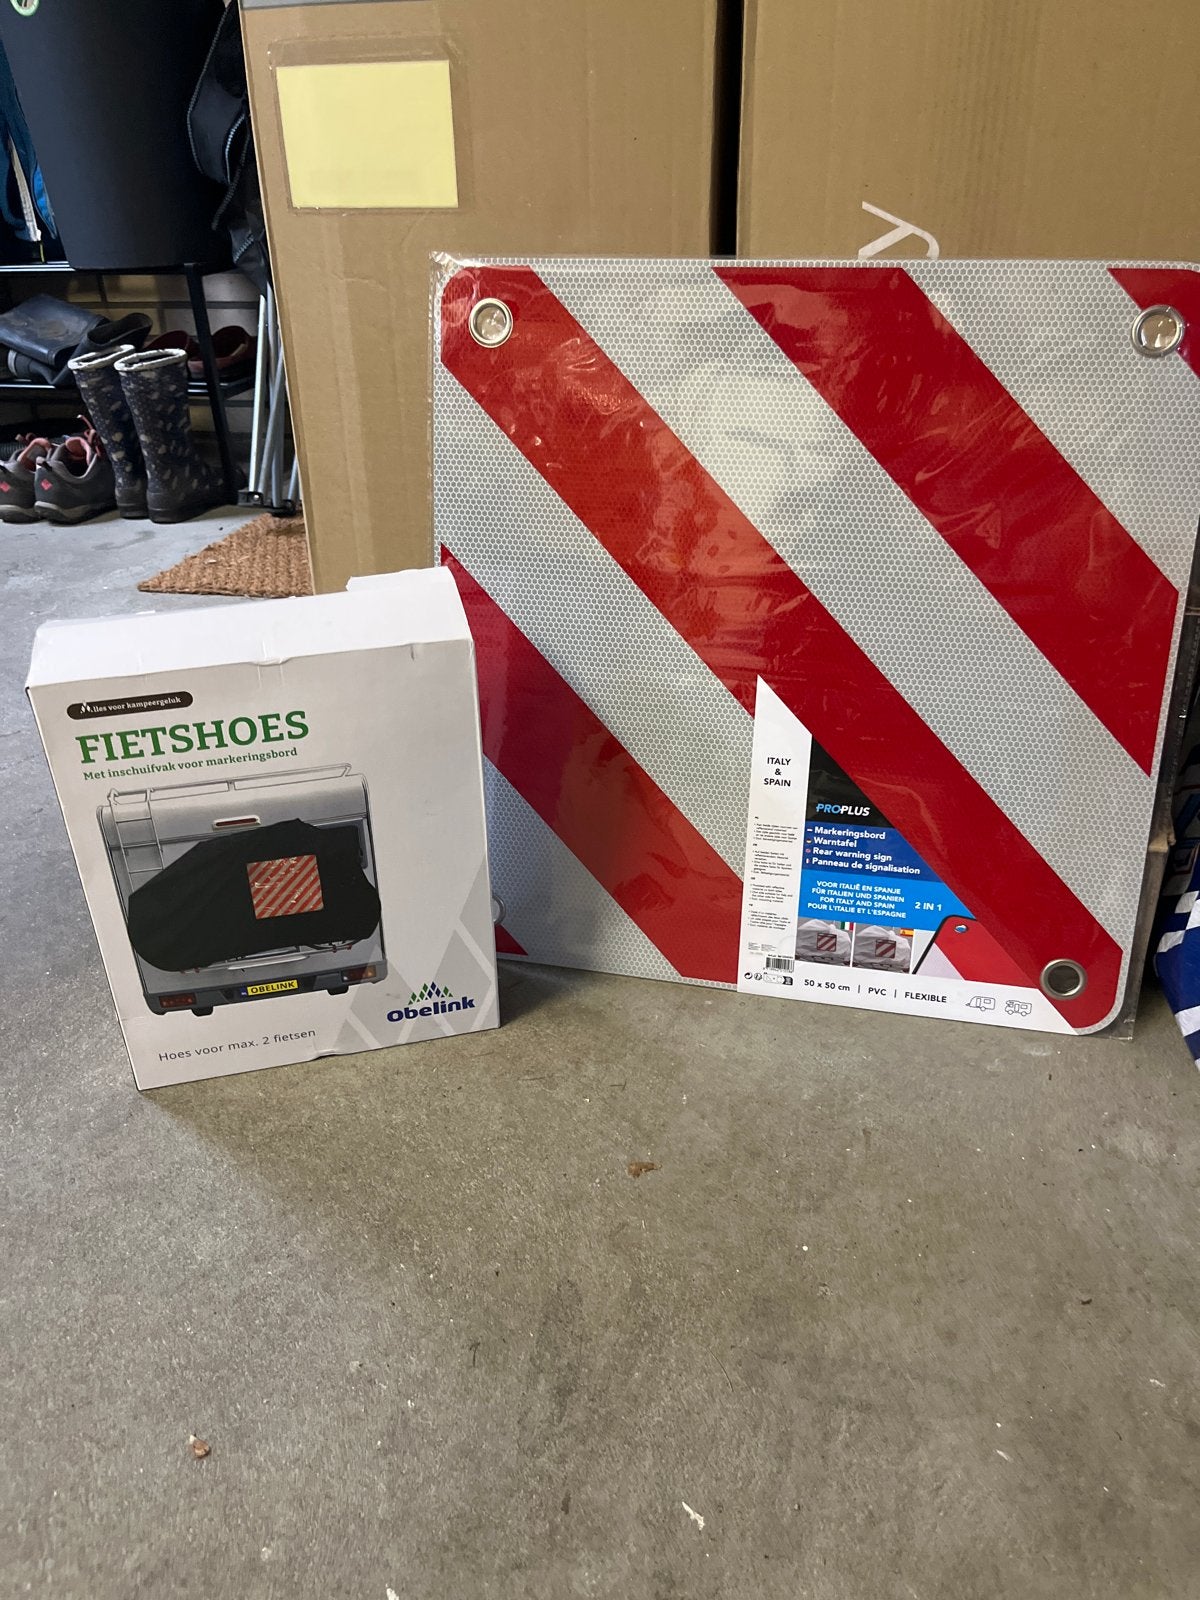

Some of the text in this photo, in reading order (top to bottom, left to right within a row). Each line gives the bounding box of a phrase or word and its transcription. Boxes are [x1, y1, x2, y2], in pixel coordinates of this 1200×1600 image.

[108, 703, 125, 711] voor
[126, 696, 182, 709] kampeergeluk
[75, 710, 309, 764] FIETSHOES
[83, 747, 298, 780] Met inschuifvak voor markeringsbord
[767, 757, 791, 766] ITALY
[774, 768, 782, 776] &
[763, 777, 791, 787] SPAIN
[816, 803, 871, 816] PROPLUS
[814, 826, 886, 840] Markeringsbord
[813, 836, 857, 848] Warntafel
[812, 847, 892, 863] Rear warning sign
[812, 857, 921, 875] Panneau de signalisation
[817, 880, 838, 889] VOOR
[873, 886, 901, 895] SPANJE
[811, 887, 826, 895] FÜR
[827, 889, 854, 898] ITALIEN
[873, 893, 905, 903] SPANIEN
[807, 902, 828, 911] POUR
[820, 896, 834, 904] FOR
[836, 897, 854, 905] ITALY
[873, 901, 895, 910] SPAIN
[915, 901, 942, 911] 2 IN 1
[250, 980, 295, 994] OBELINK
[804, 979, 815, 987] 50
[824, 981, 836, 990] 50
[838, 984, 850, 992] cm
[868, 987, 887, 996] PVC
[904, 991, 947, 1003] FLEXIBLE
[158, 1029, 316, 1062] Hoes voor max. 2 fietsen
